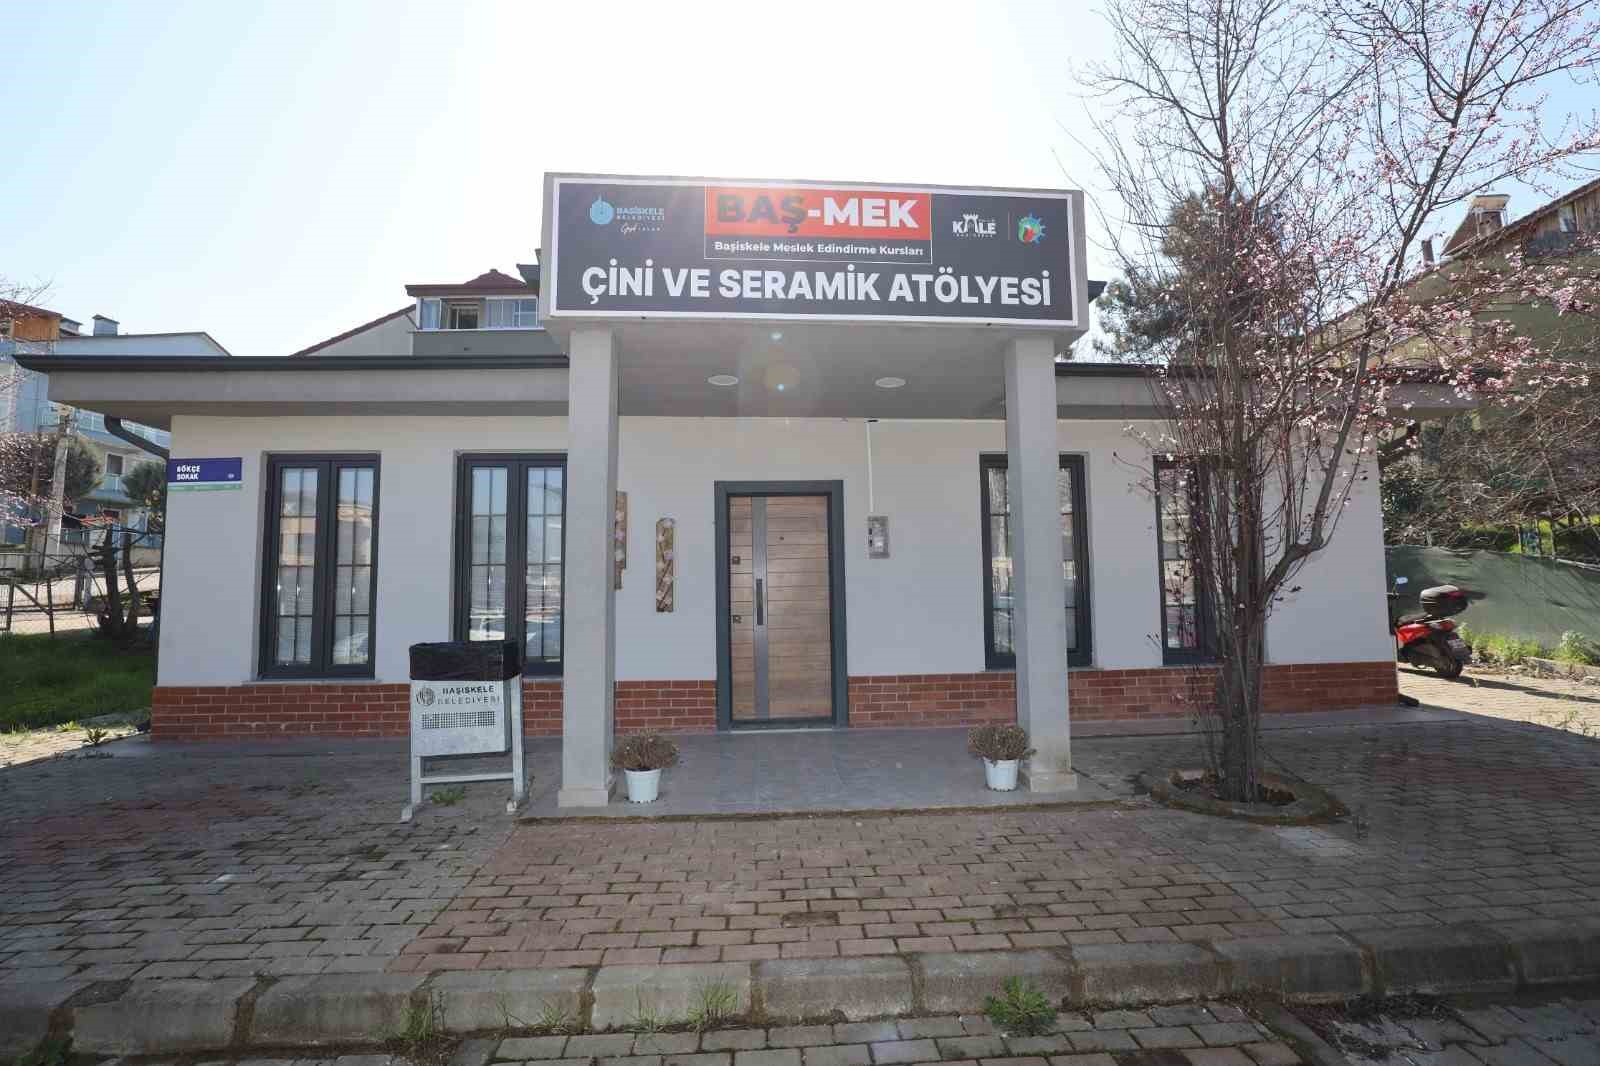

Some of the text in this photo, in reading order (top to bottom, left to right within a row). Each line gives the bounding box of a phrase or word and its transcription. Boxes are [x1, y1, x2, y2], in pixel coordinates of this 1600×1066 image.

[716, 192, 919, 233] BAŞ-MEK
[952, 214, 997, 235] KALE
[714, 241, 924, 257] Başiskele Meslek Edindirme Kursları
[582, 258, 1051, 306] ÇİNİ VE SERAMİK ATÖLYESİ
